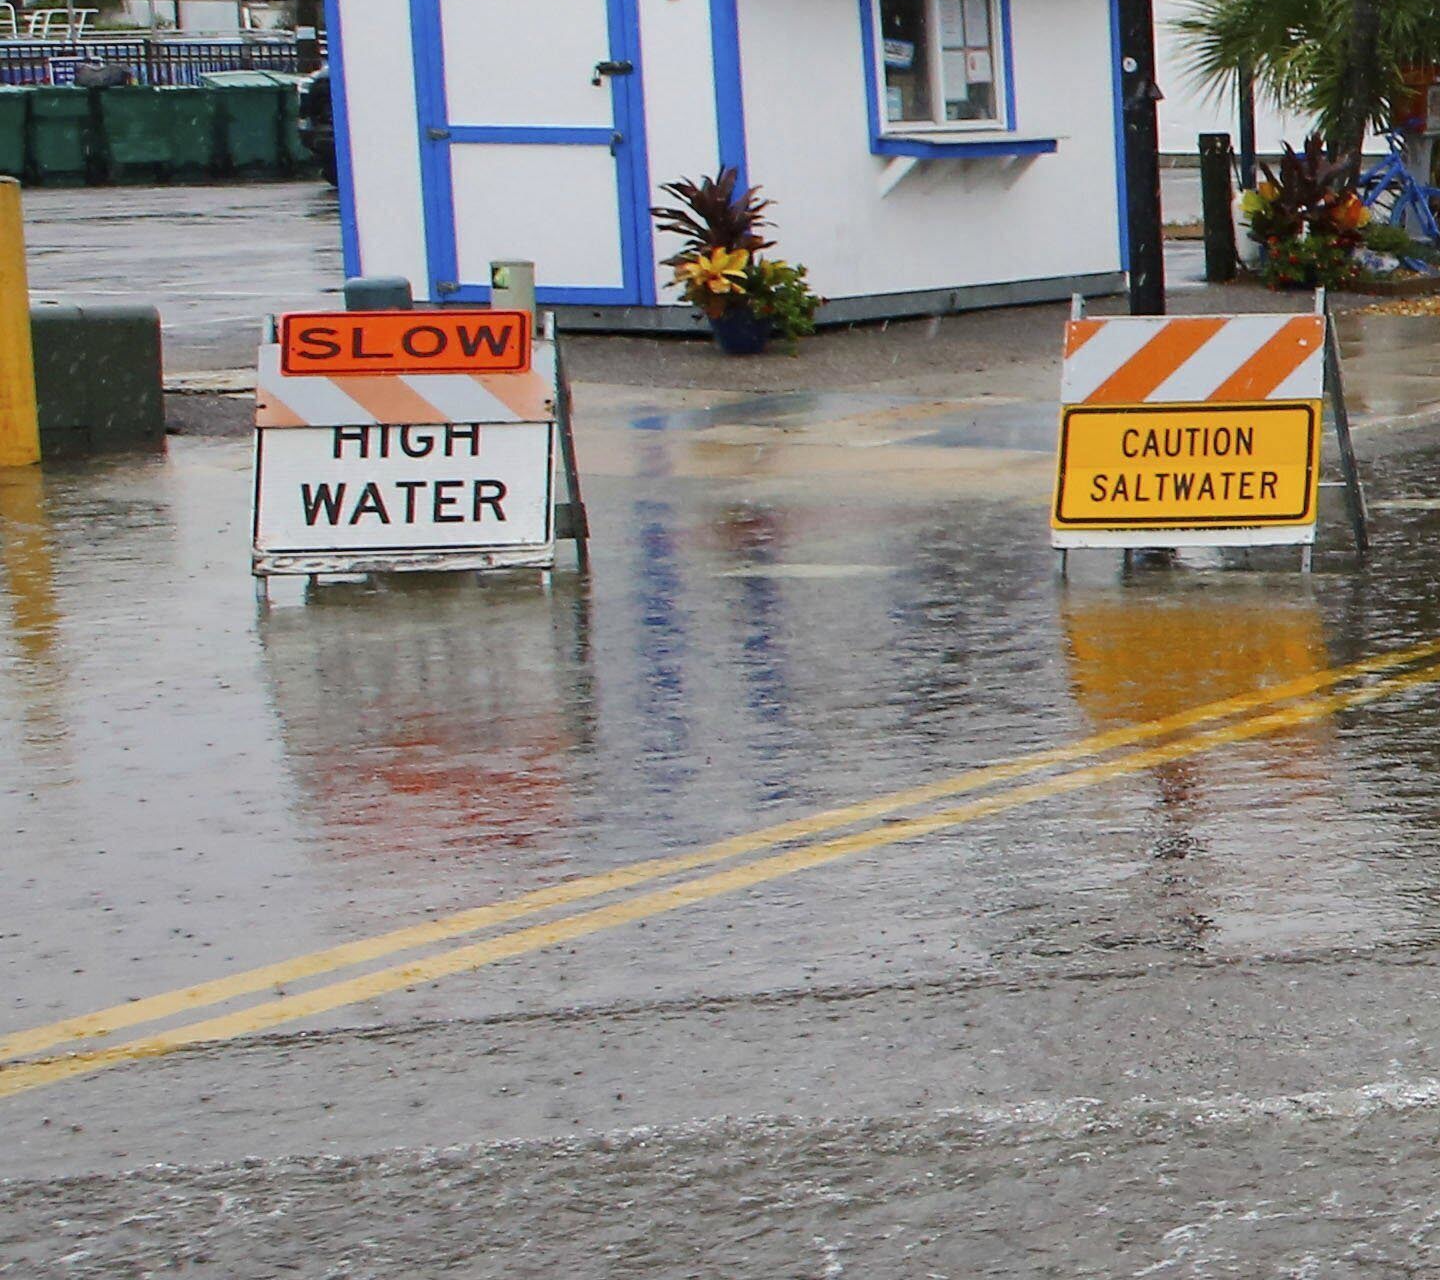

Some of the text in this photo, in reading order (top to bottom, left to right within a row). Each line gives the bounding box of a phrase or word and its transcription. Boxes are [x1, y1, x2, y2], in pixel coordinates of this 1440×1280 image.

[297, 325, 513, 360] SLOW
[333, 422, 480, 458] HIGH
[1122, 426, 1254, 458] CAUTION
[301, 480, 508, 526] WATER
[1089, 471, 1279, 502] SALTWATER
